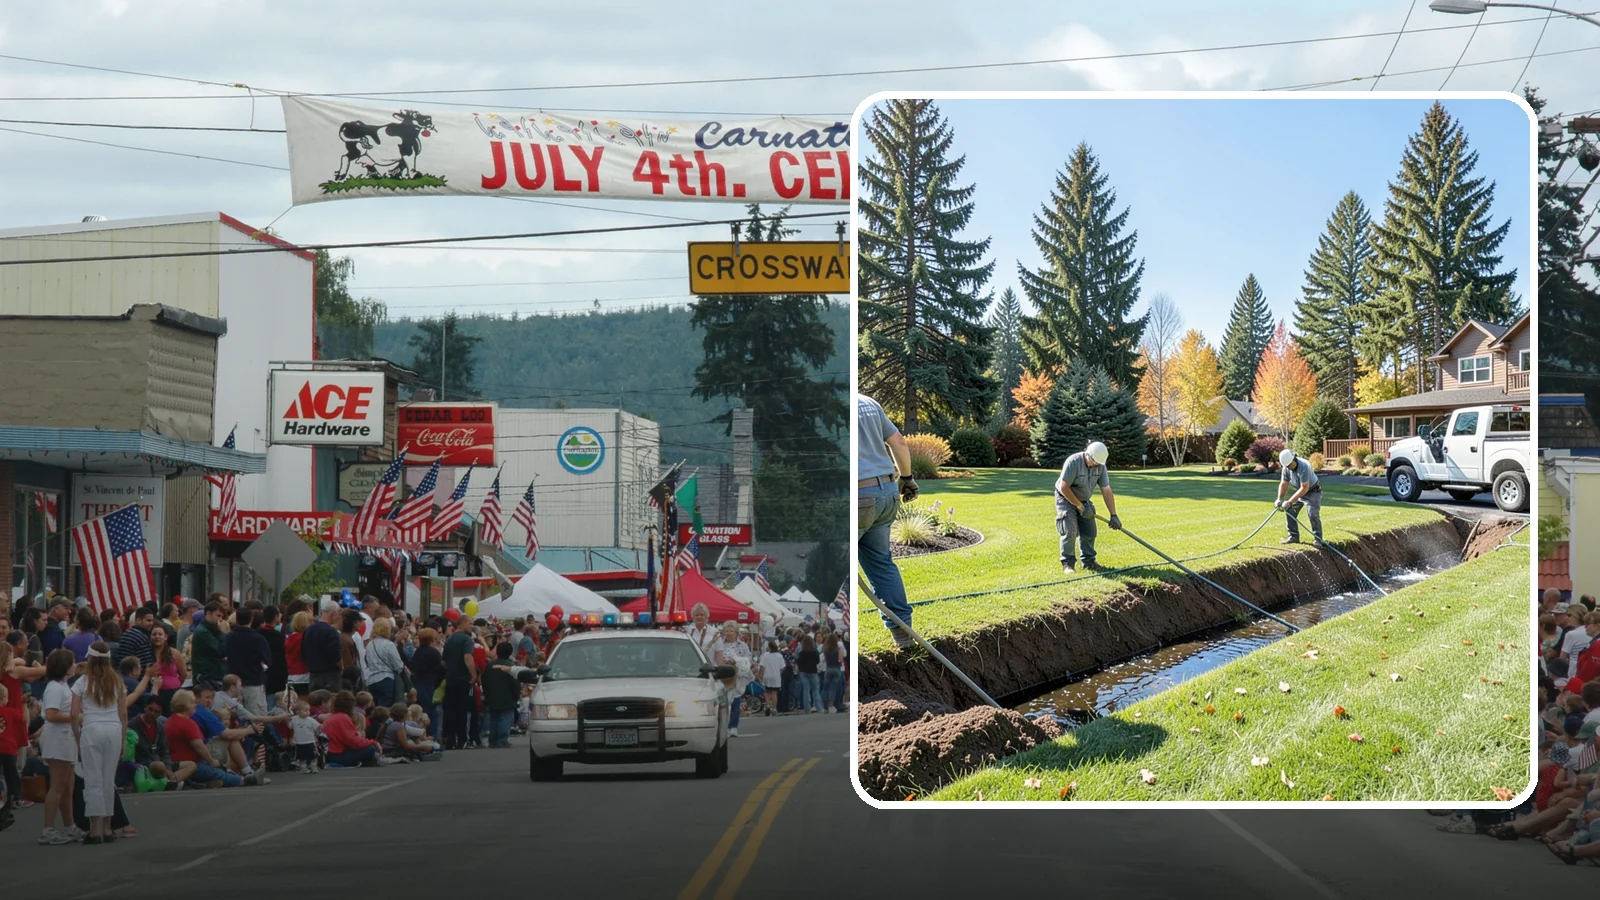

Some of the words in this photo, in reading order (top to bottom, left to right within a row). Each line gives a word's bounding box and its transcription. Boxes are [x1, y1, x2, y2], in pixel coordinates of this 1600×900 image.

[695, 121, 850, 150] Carnat
[481, 141, 605, 193] JULY
[632, 150, 746, 198] 4th.
[697, 254, 850, 280] CROSSWA
[283, 380, 373, 420] ACE
[405, 409, 452, 422] CEDAR
[283, 420, 371, 436] Hardware
[416, 428, 477, 447] Coca-Cola
[83, 485, 94, 494] St.
[96, 485, 124, 495] Vincent
[126, 486, 136, 495] de
[137, 486, 155, 495] Paul
[212, 516, 331, 535] HARDARE
[688, 526, 741, 535] CRNATION
[699, 535, 730, 543] GLASS
